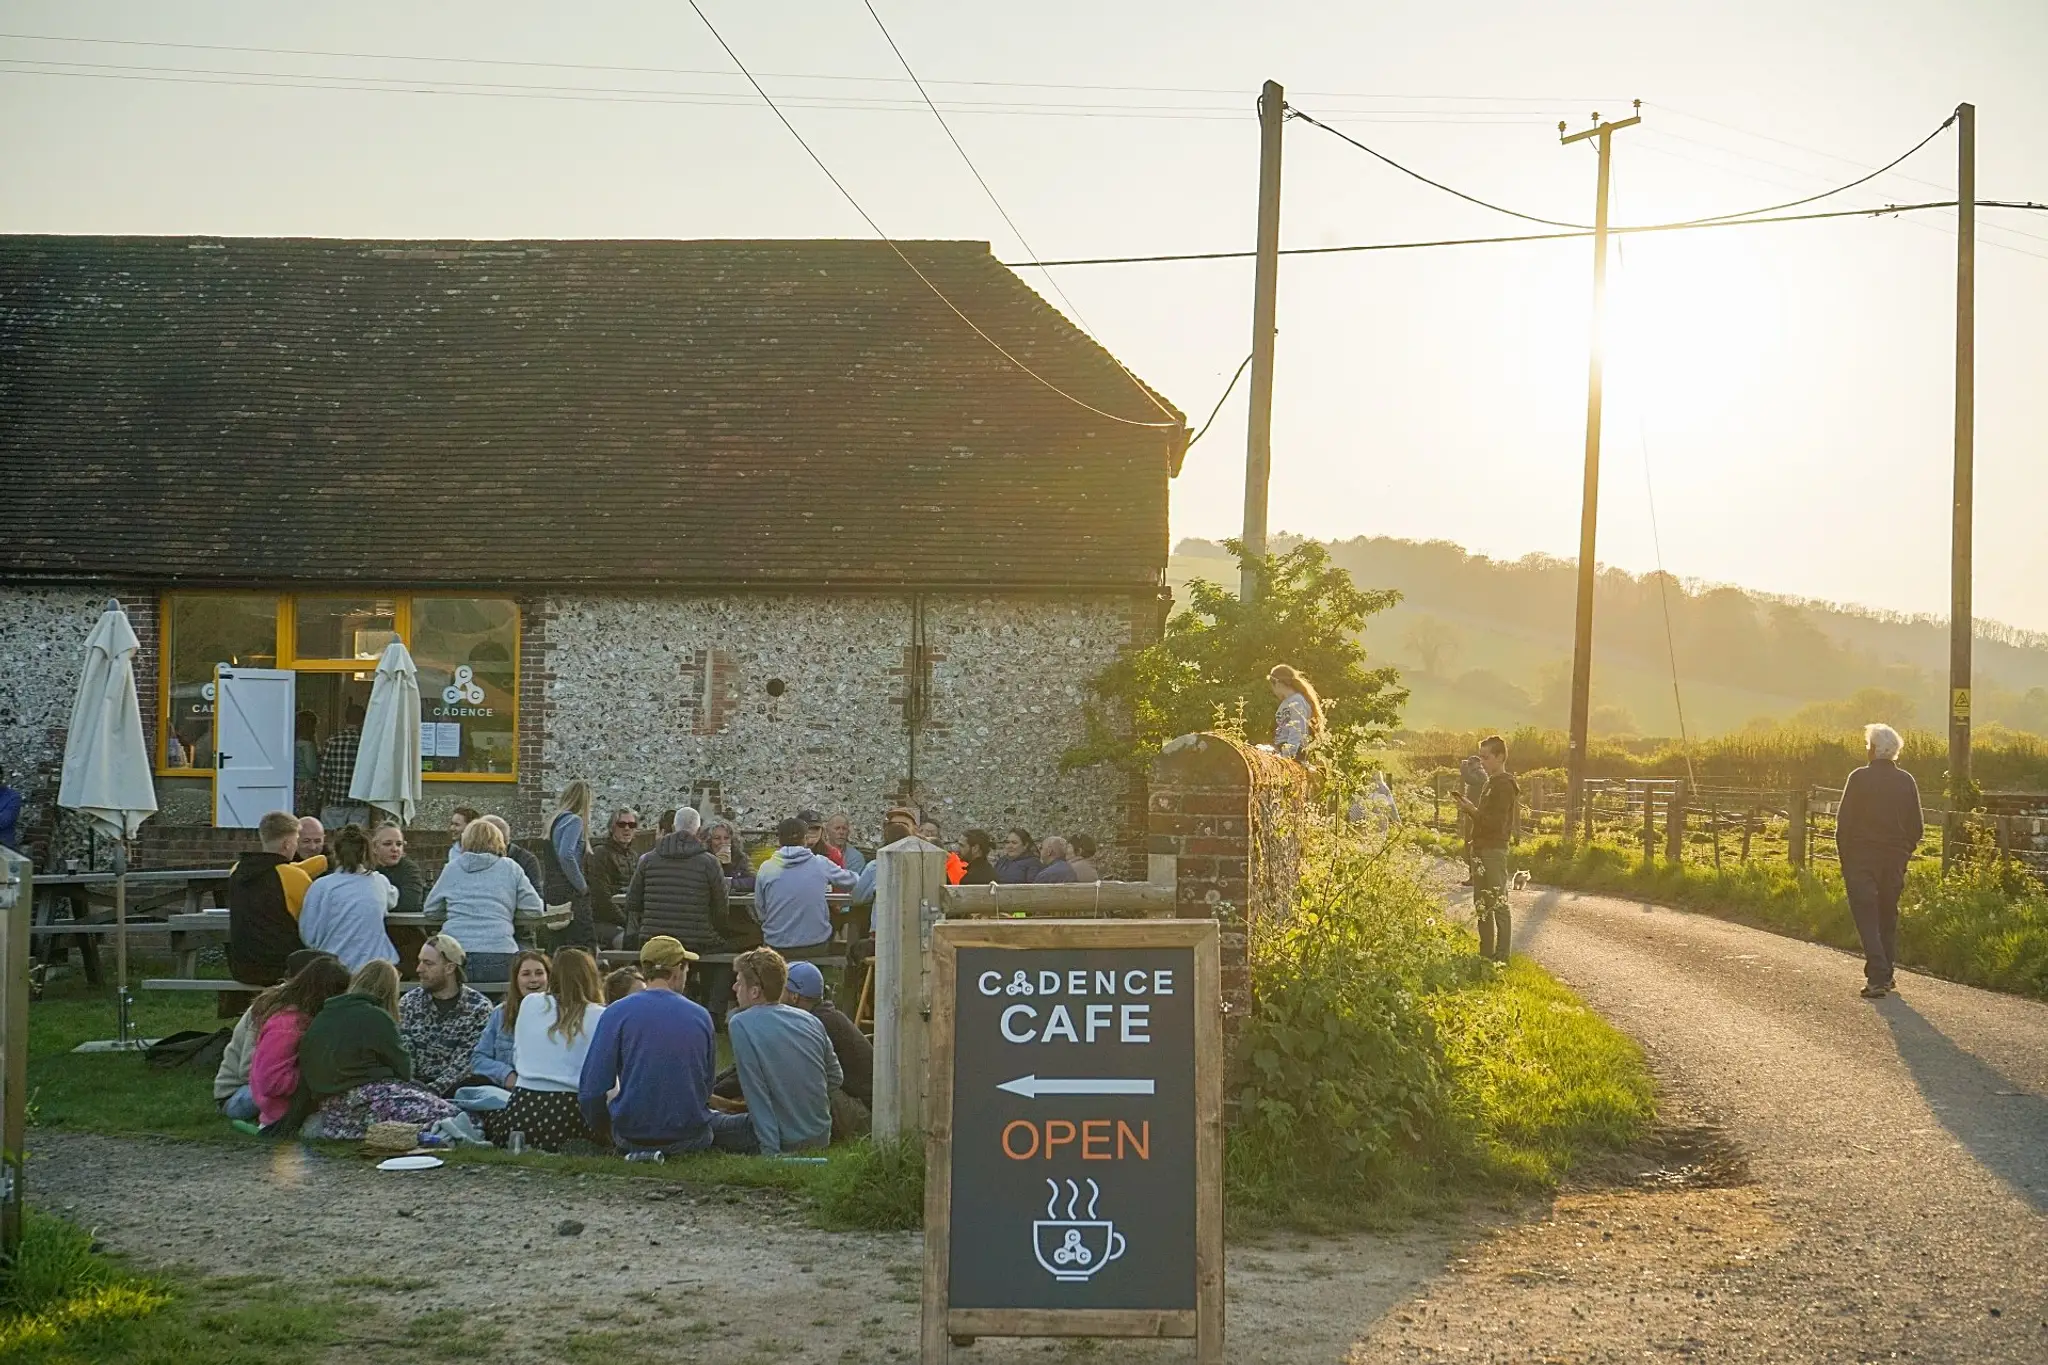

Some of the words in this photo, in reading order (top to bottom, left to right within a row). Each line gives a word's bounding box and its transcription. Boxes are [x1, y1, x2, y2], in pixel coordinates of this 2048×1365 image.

[433, 707, 493, 717] CADENCE
[1000, 1004, 1150, 1043] CAFE
[1002, 1120, 1149, 1160] OPEN
